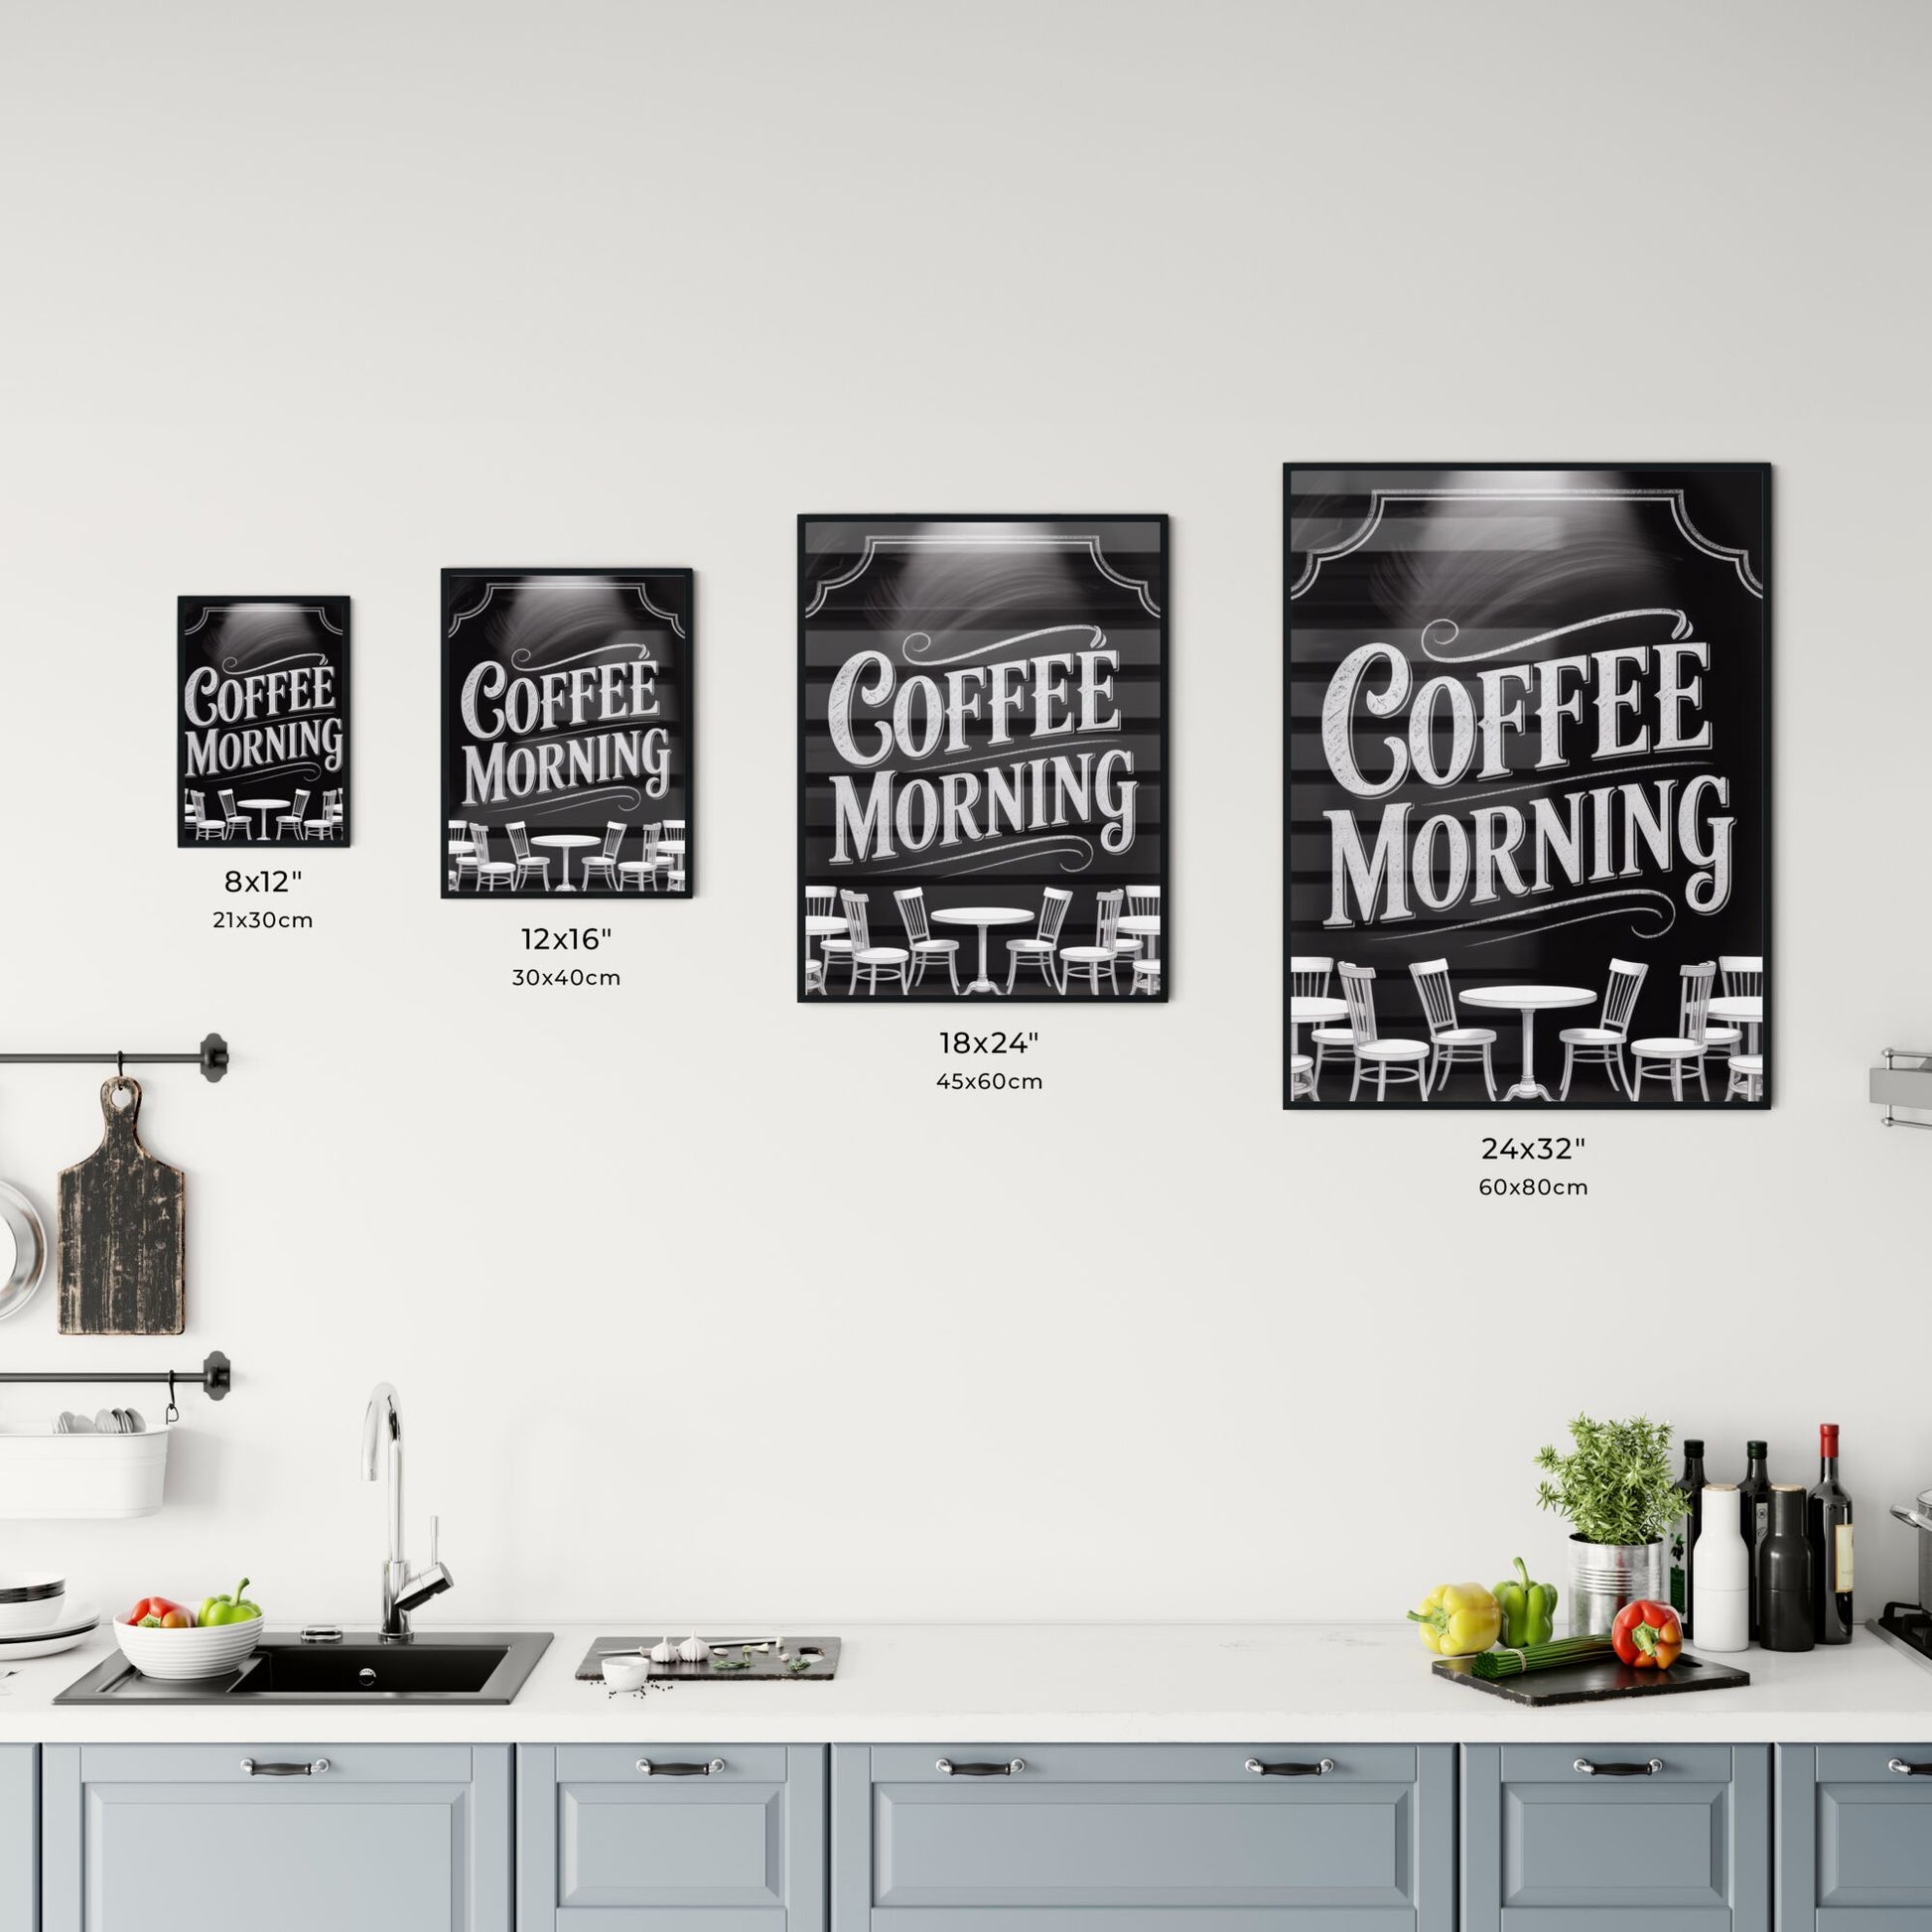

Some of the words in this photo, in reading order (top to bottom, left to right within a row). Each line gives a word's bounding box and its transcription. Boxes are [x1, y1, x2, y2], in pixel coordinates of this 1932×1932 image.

[185, 666, 337, 729] COFFEE
[461, 660, 661, 742] COFFEE
[828, 650, 1122, 768] COFFEE
[1321, 642, 1713, 799] COFFEE
[185, 718, 343, 778] MORNING
[462, 728, 673, 807] MORNING
[828, 750, 1140, 866] MORNING
[1322, 774, 1737, 929] MORNING
